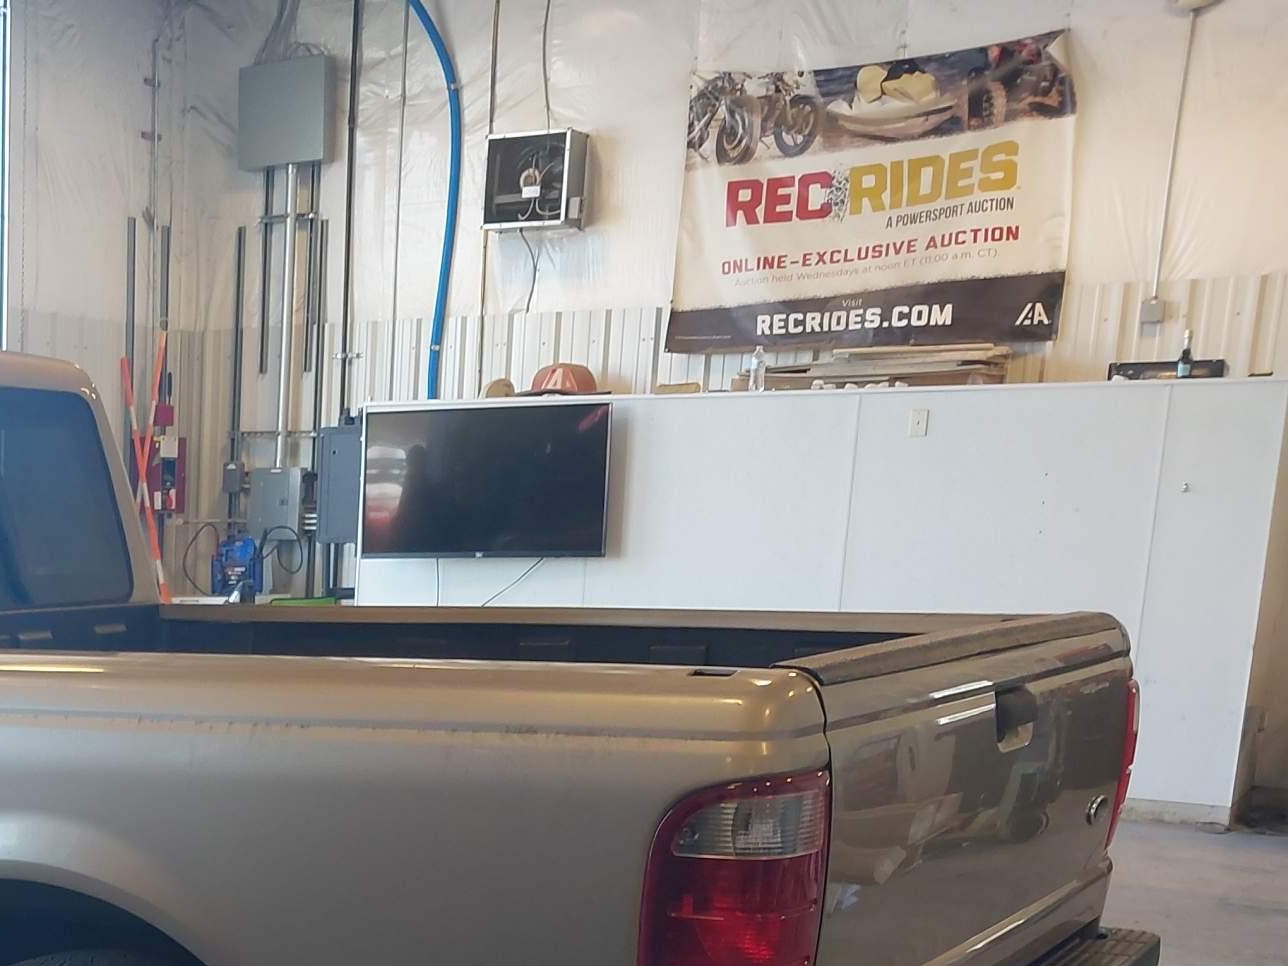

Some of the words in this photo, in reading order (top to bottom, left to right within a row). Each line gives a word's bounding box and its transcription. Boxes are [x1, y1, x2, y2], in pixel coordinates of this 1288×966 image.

[726, 171, 834, 228] REC
[848, 139, 1020, 216] RIDES
[885, 215, 893, 230] A
[895, 203, 965, 227] POWERSPORT
[966, 197, 1015, 215] AUCTION
[721, 238, 918, 275] ONLINE-EXCLUSIVE
[925, 225, 1020, 251] AUCTION
[796, 266, 861, 281] Wednesdays
[756, 303, 953, 336] RECRIDES.COM
[841, 298, 863, 308] Visit
